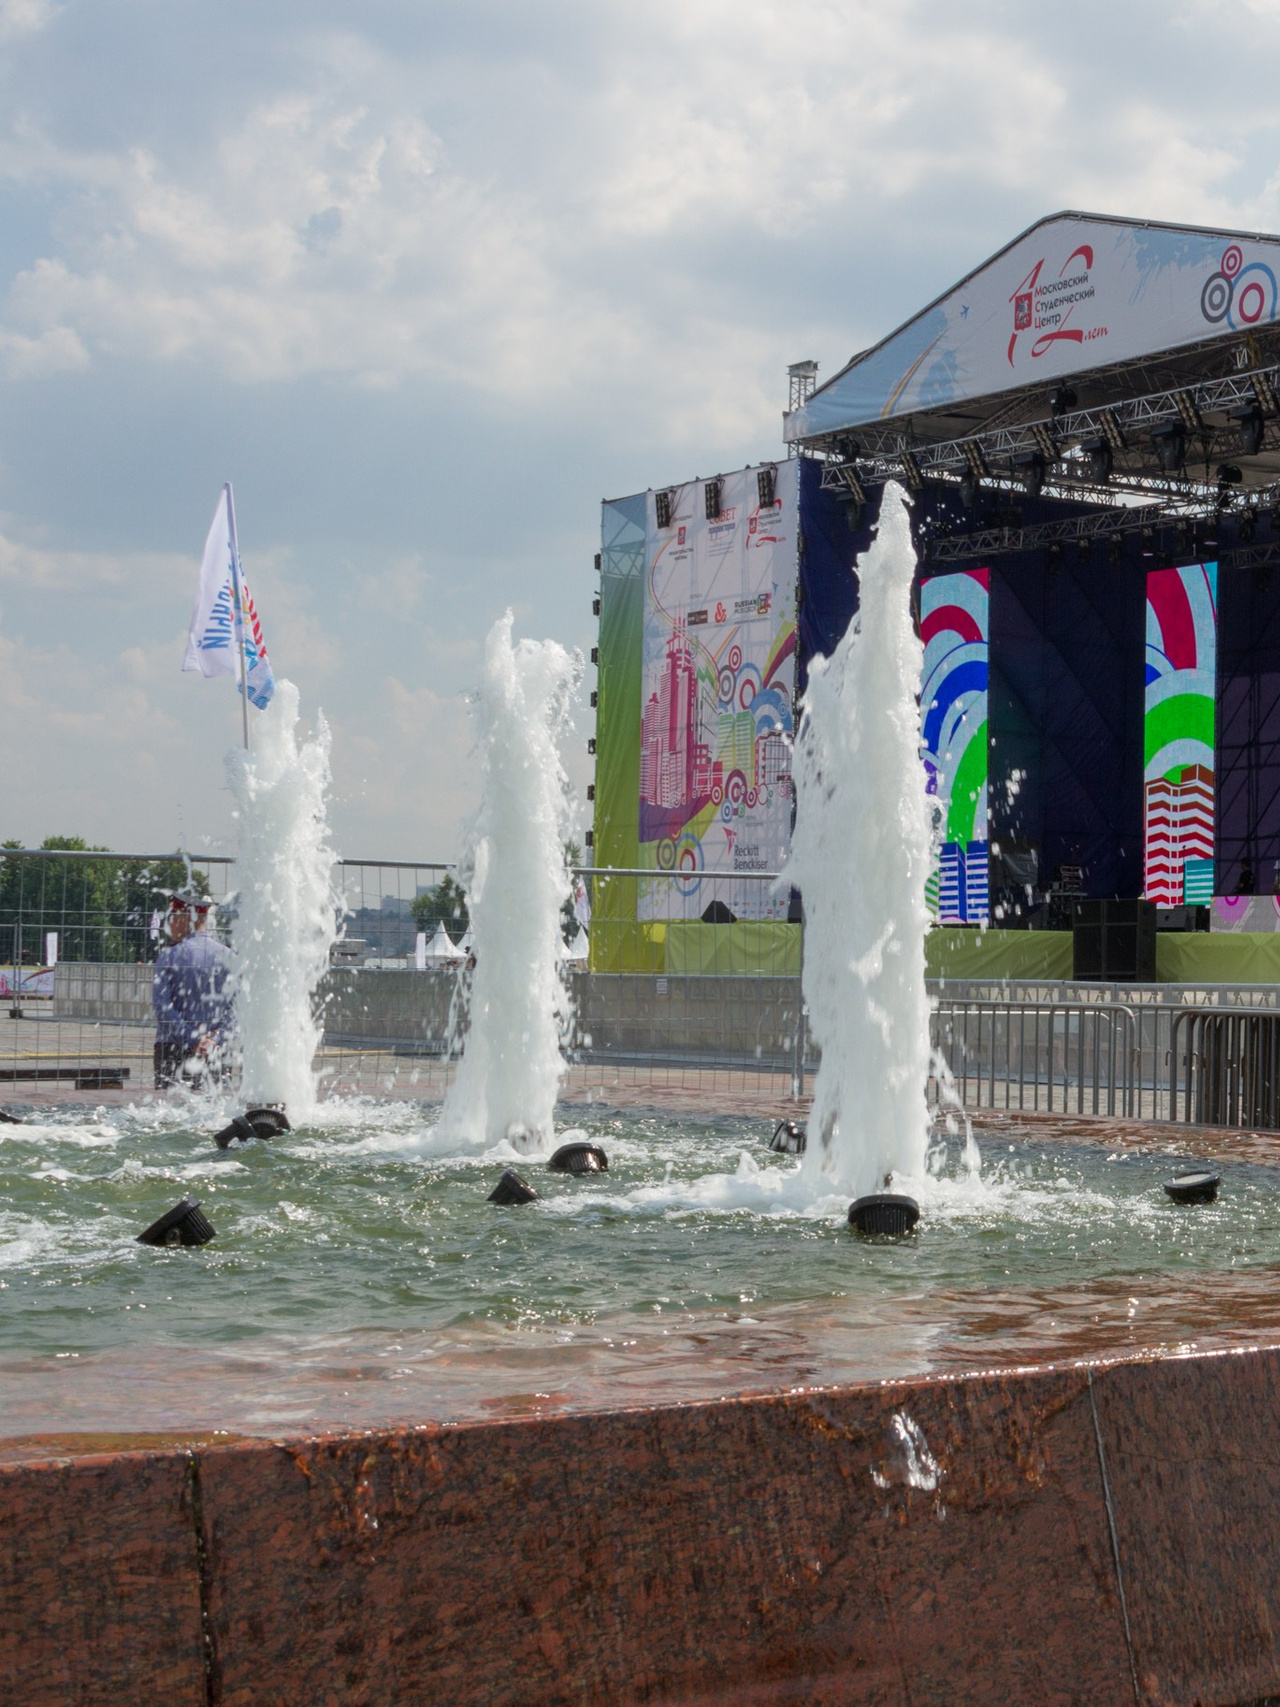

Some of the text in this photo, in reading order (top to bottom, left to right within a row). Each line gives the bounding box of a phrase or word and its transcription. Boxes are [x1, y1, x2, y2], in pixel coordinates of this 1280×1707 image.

[1034, 272, 1089, 298] Московский
[1034, 286, 1095, 314] Студенческий
[1034, 313, 1062, 330] Центр
[734, 844, 759, 857] Reckitt
[733, 858, 768, 870] Benckiser
